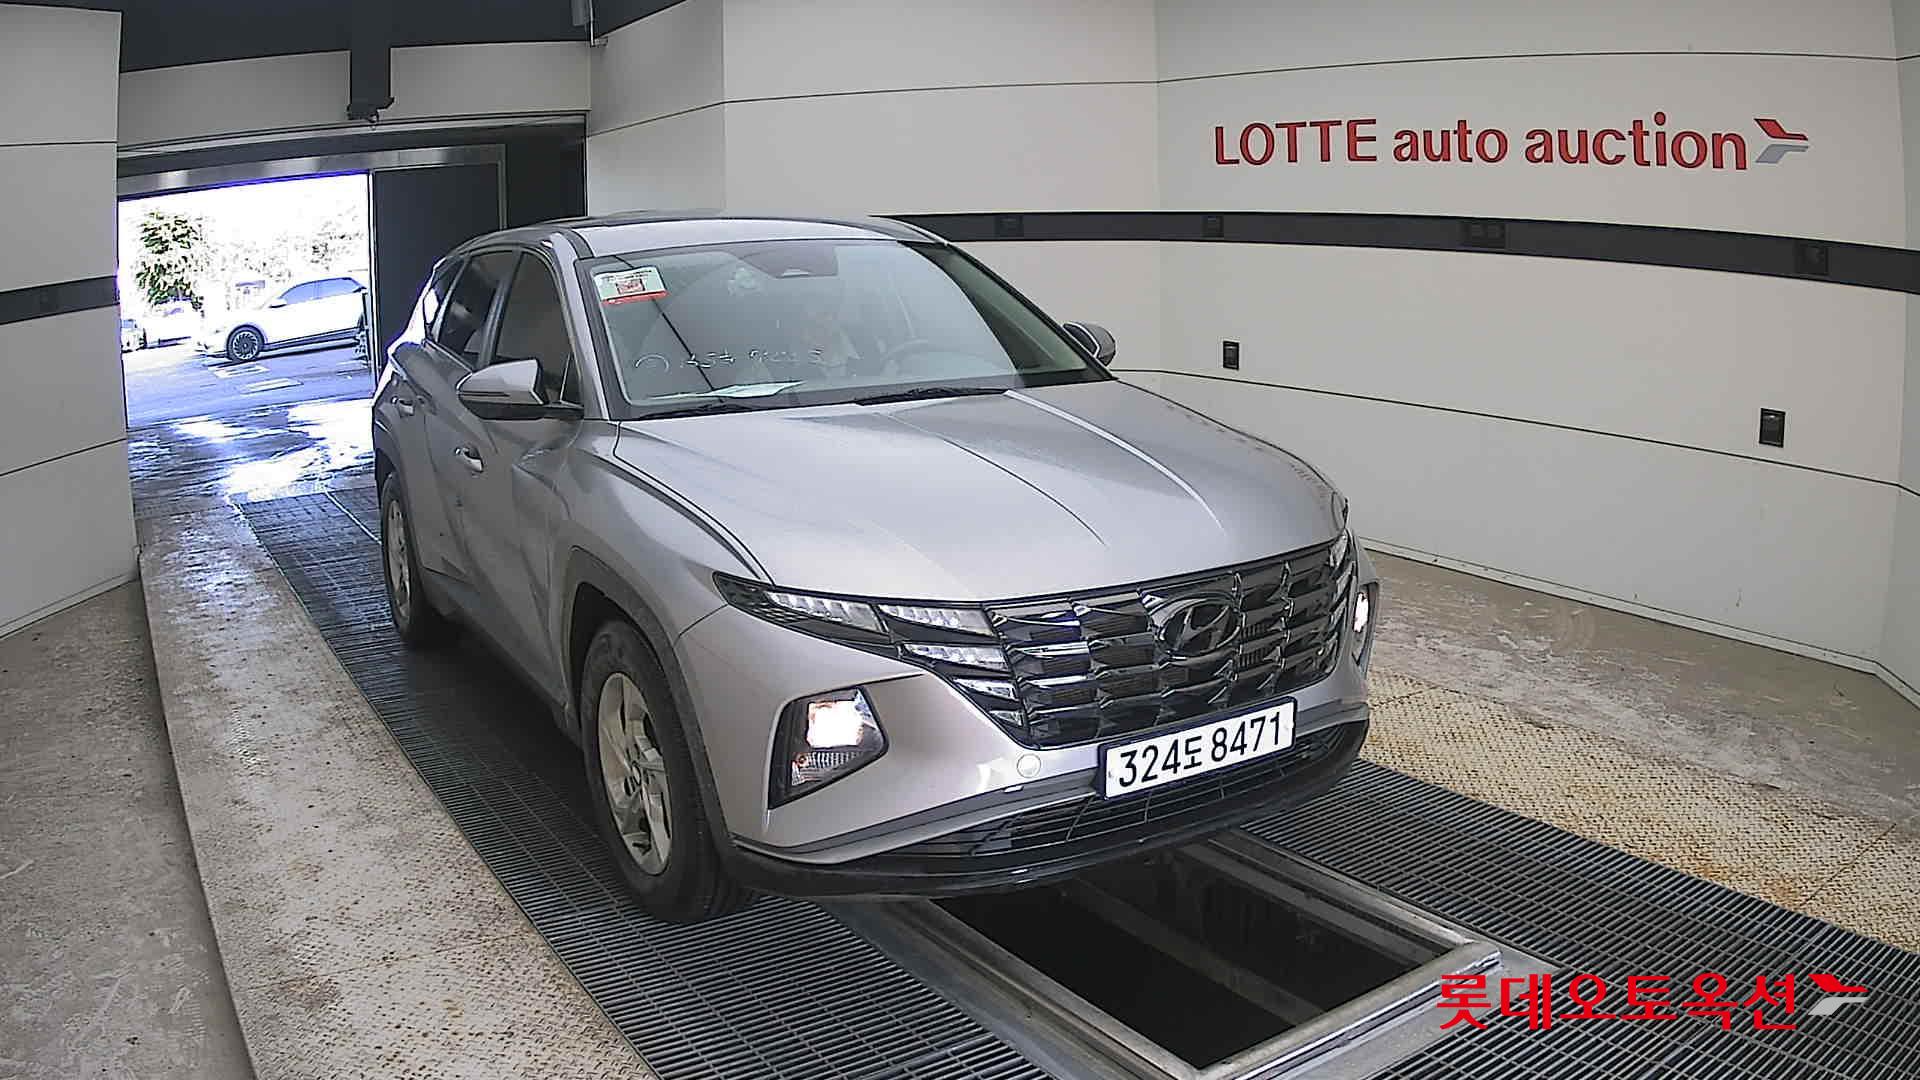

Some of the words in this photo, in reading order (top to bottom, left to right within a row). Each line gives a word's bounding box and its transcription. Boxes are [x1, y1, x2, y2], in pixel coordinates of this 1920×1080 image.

[1215, 119, 1377, 165] LOTTE
[1394, 119, 1509, 163] auto
[1525, 112, 1748, 170] auction
[1118, 735, 1203, 788] 324도
[1211, 711, 1281, 763] 8471
